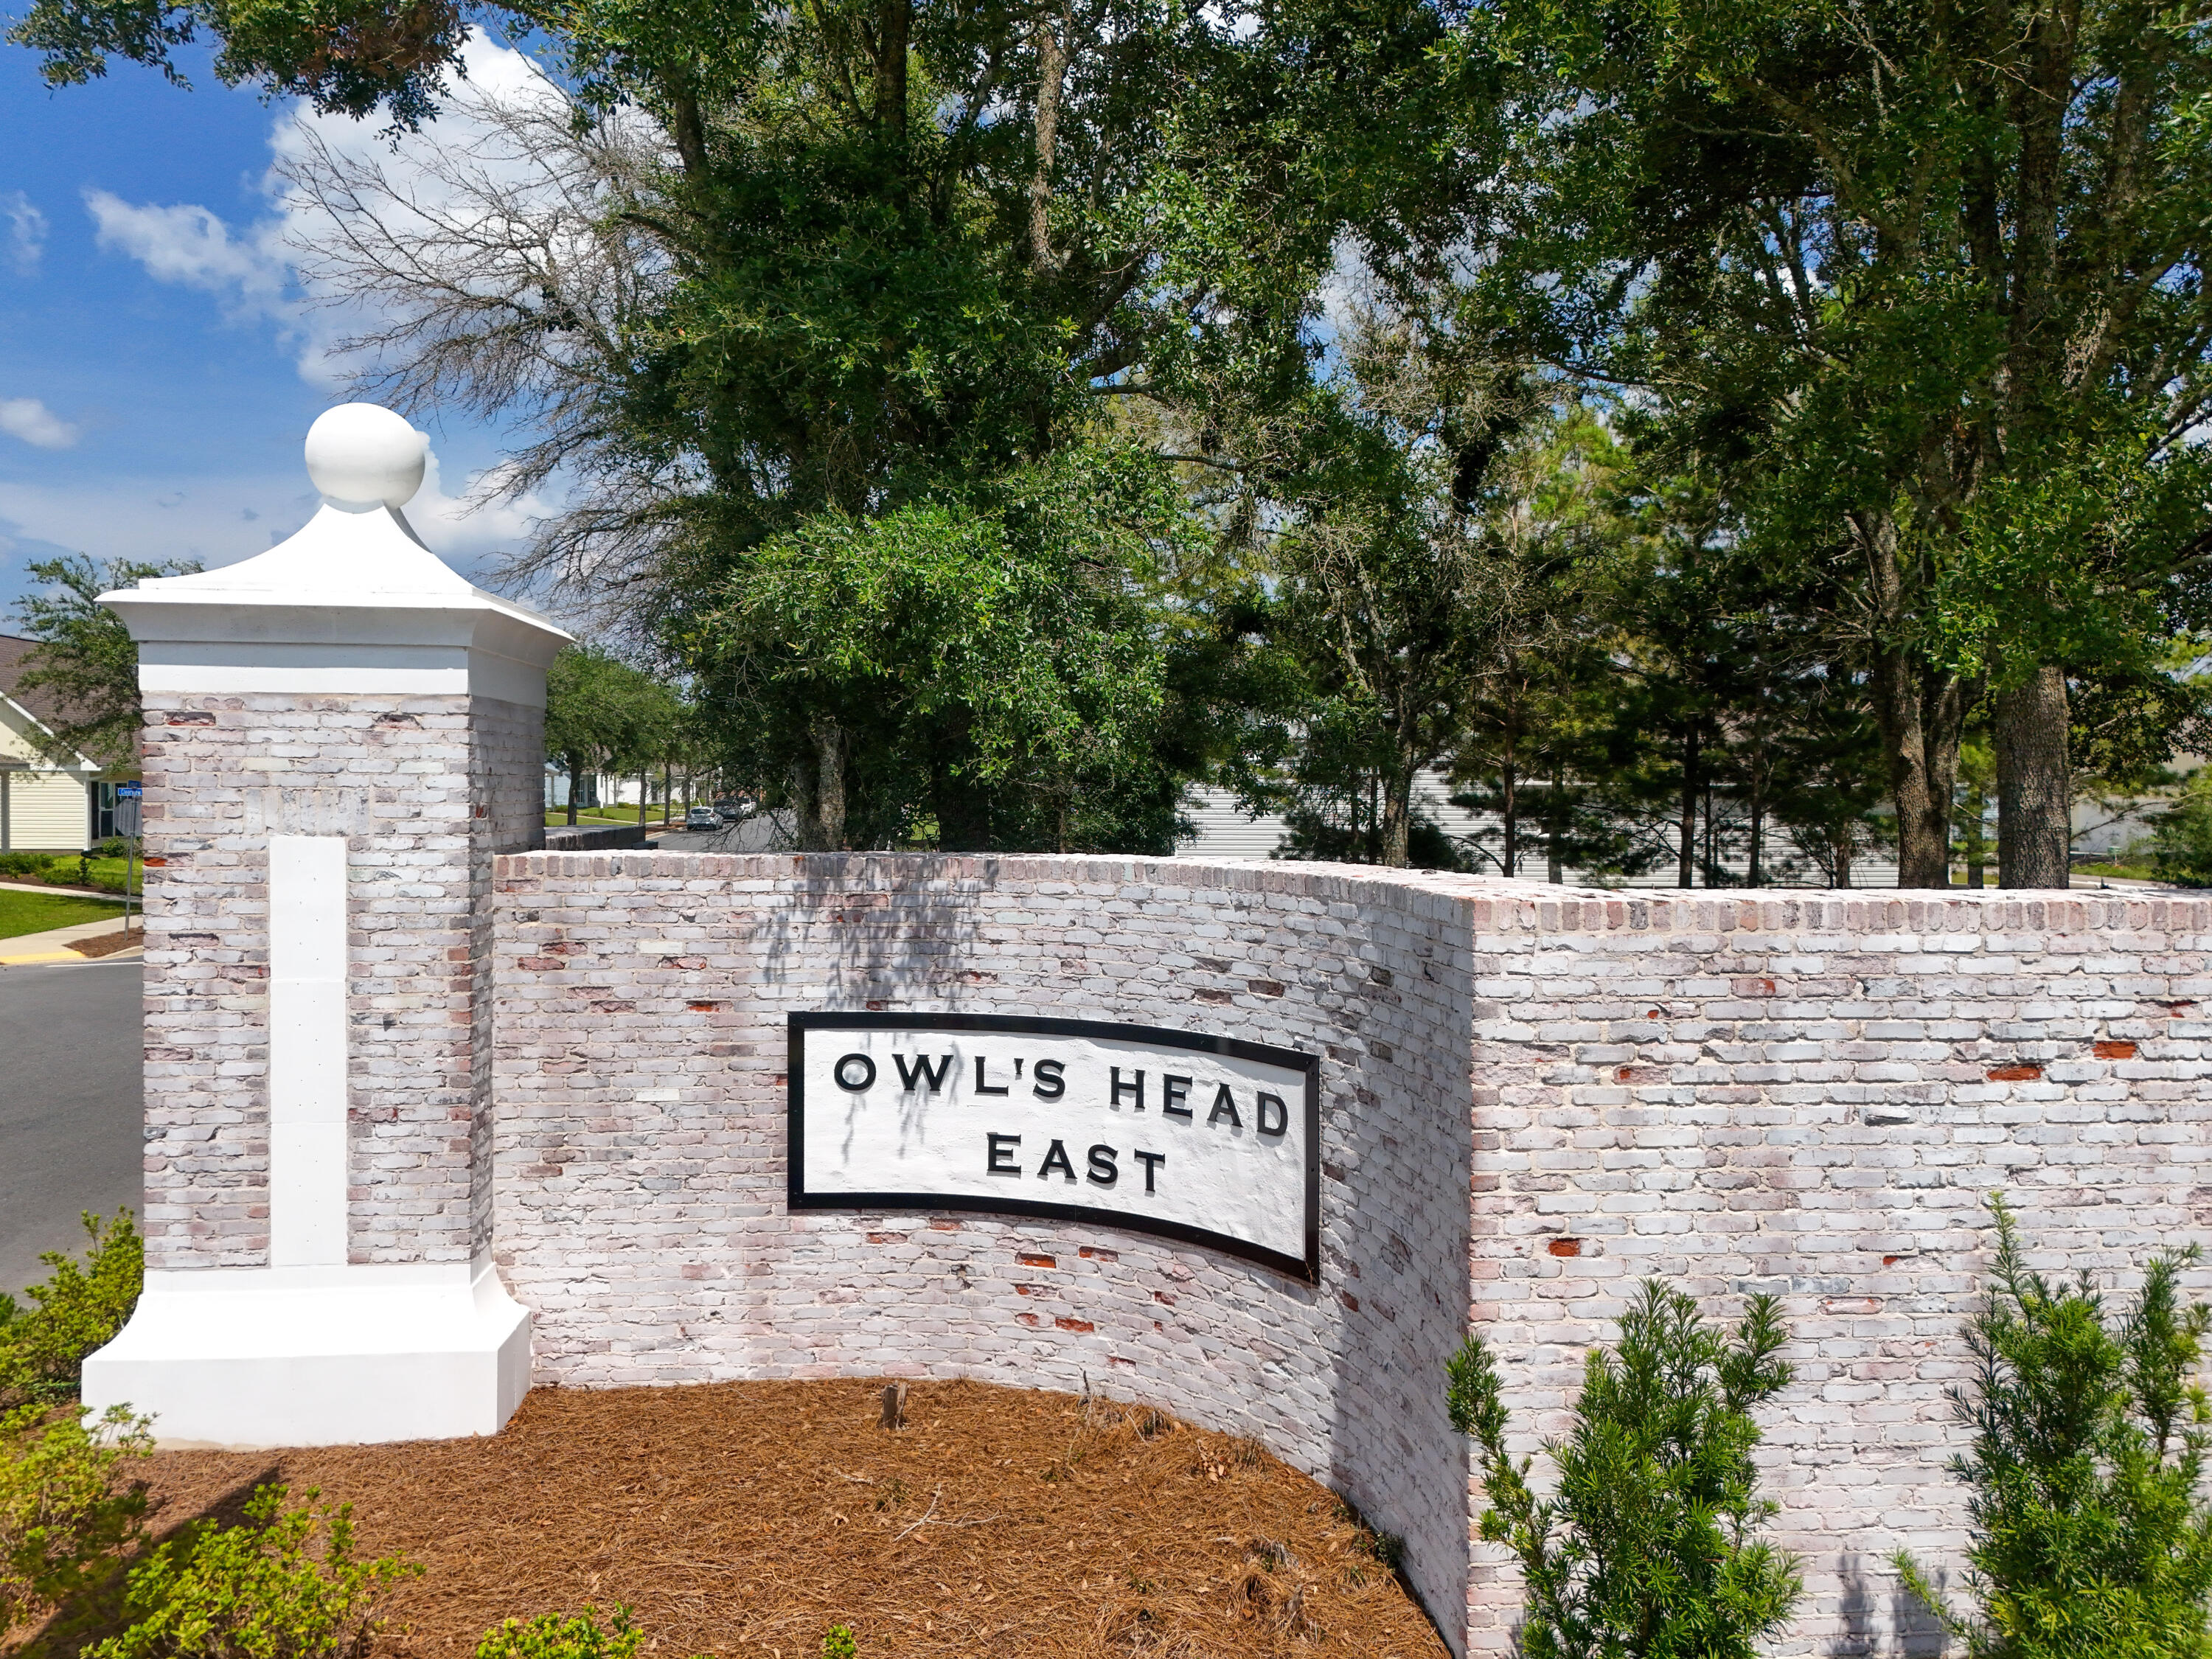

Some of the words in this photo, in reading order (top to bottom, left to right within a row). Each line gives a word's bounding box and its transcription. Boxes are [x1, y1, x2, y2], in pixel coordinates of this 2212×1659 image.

[834, 1053, 1066, 1098] OWL'S
[1110, 1066, 1288, 1136] HEAD
[987, 1133, 1166, 1192] EAST
